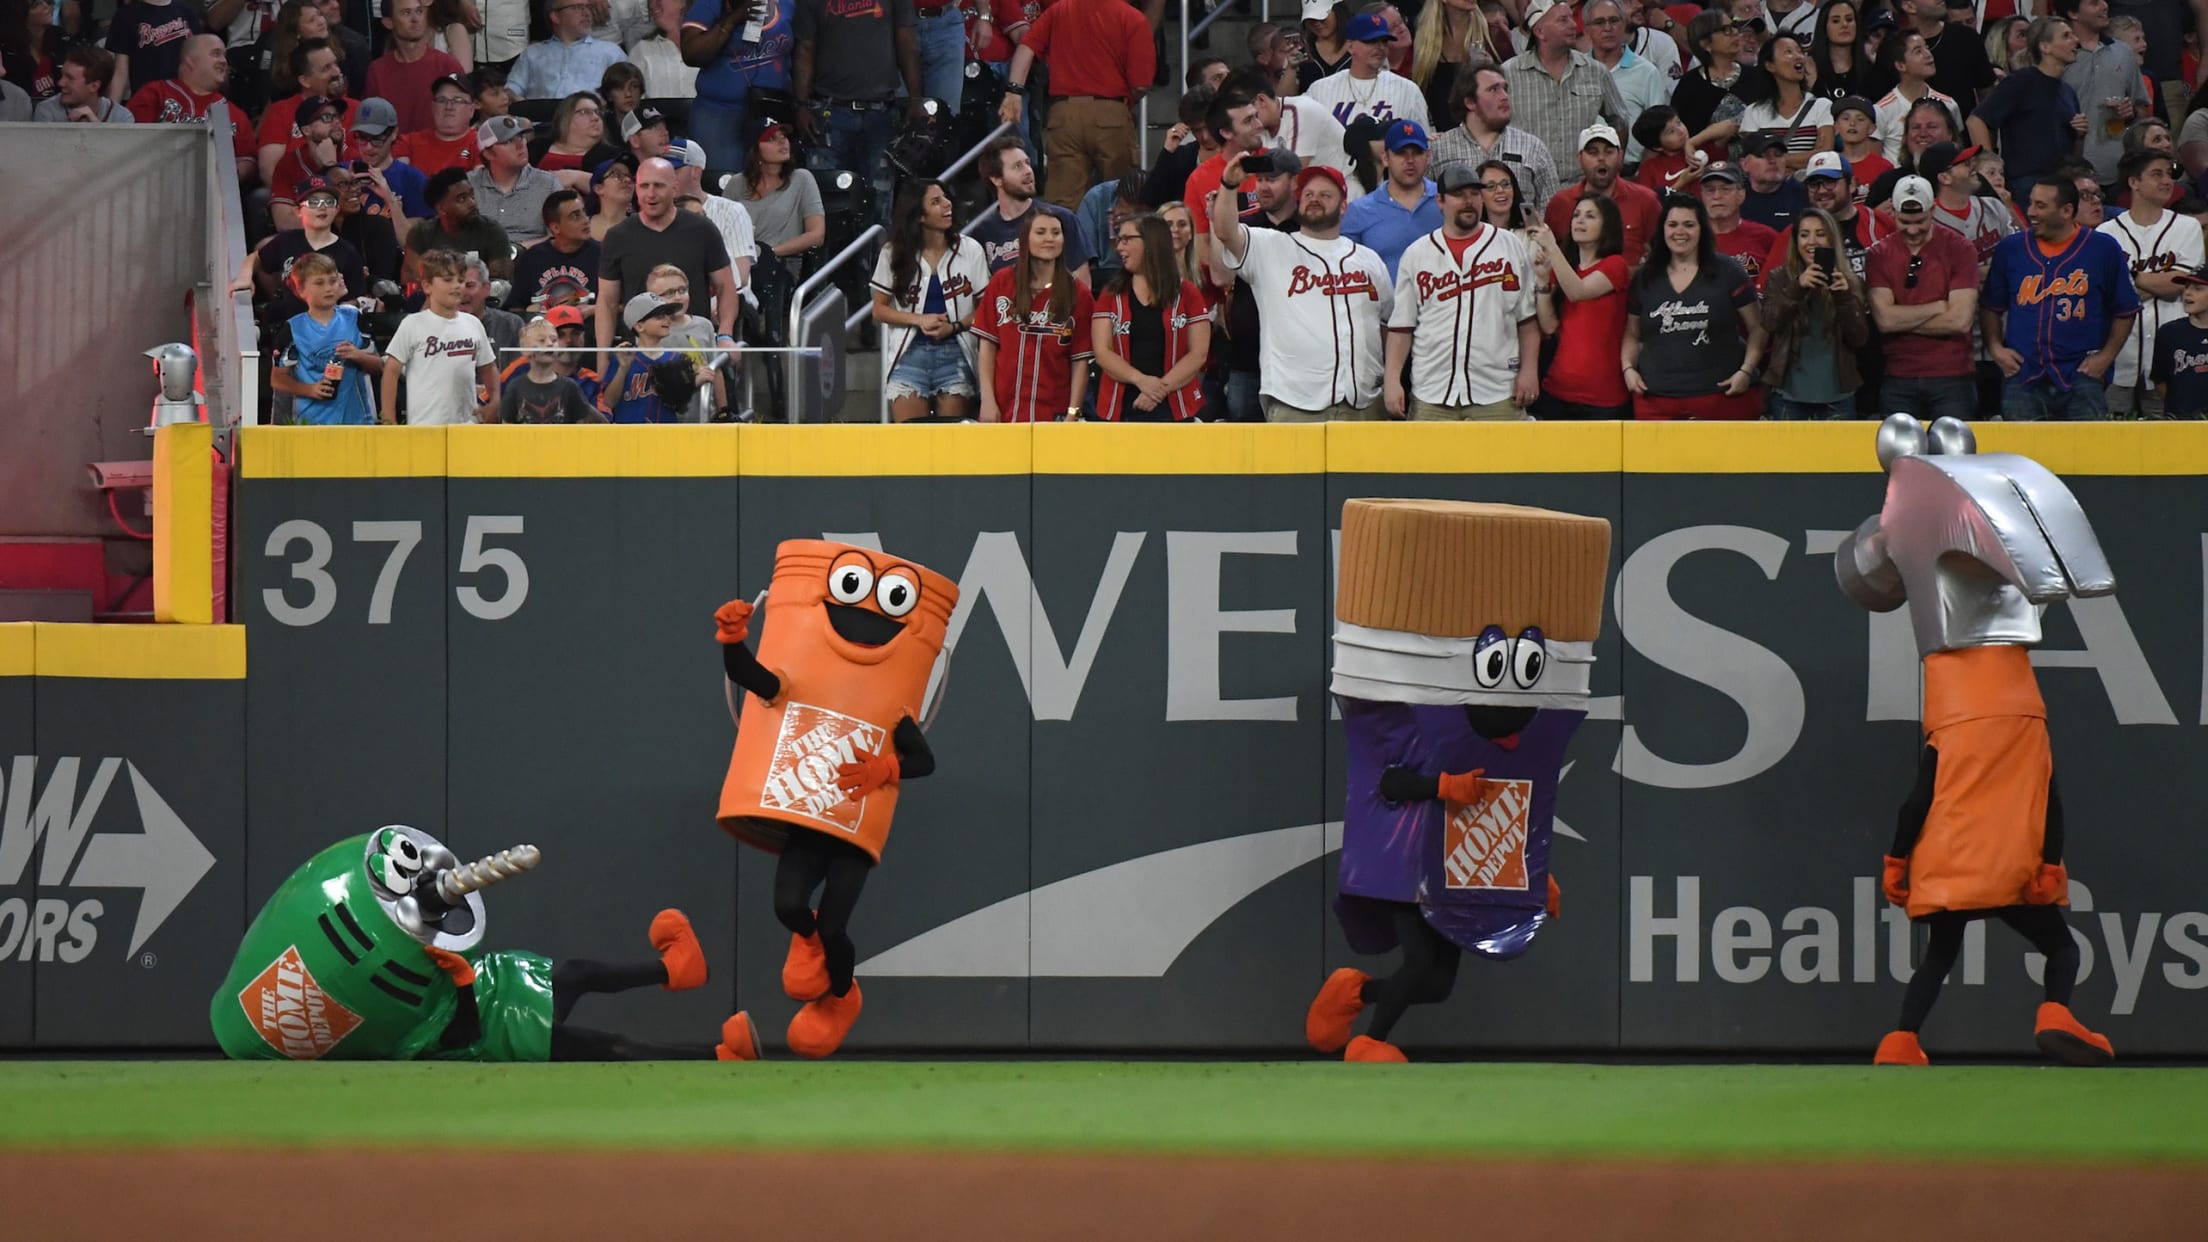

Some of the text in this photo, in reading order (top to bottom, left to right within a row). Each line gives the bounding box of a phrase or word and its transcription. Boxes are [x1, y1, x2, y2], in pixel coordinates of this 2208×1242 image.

[1288, 265, 1366, 297] Braves
[2017, 268, 2089, 306] Mets
[2056, 298, 2086, 322] 34
[424, 335, 476, 358] Braves
[262, 516, 529, 627] 375
[1446, 781, 1529, 887] HOME
[1477, 821, 1526, 887] DEPOT
[261, 987, 278, 1030] THE
[276, 956, 317, 1056] HOME
[304, 983, 334, 1045] DEPOT
